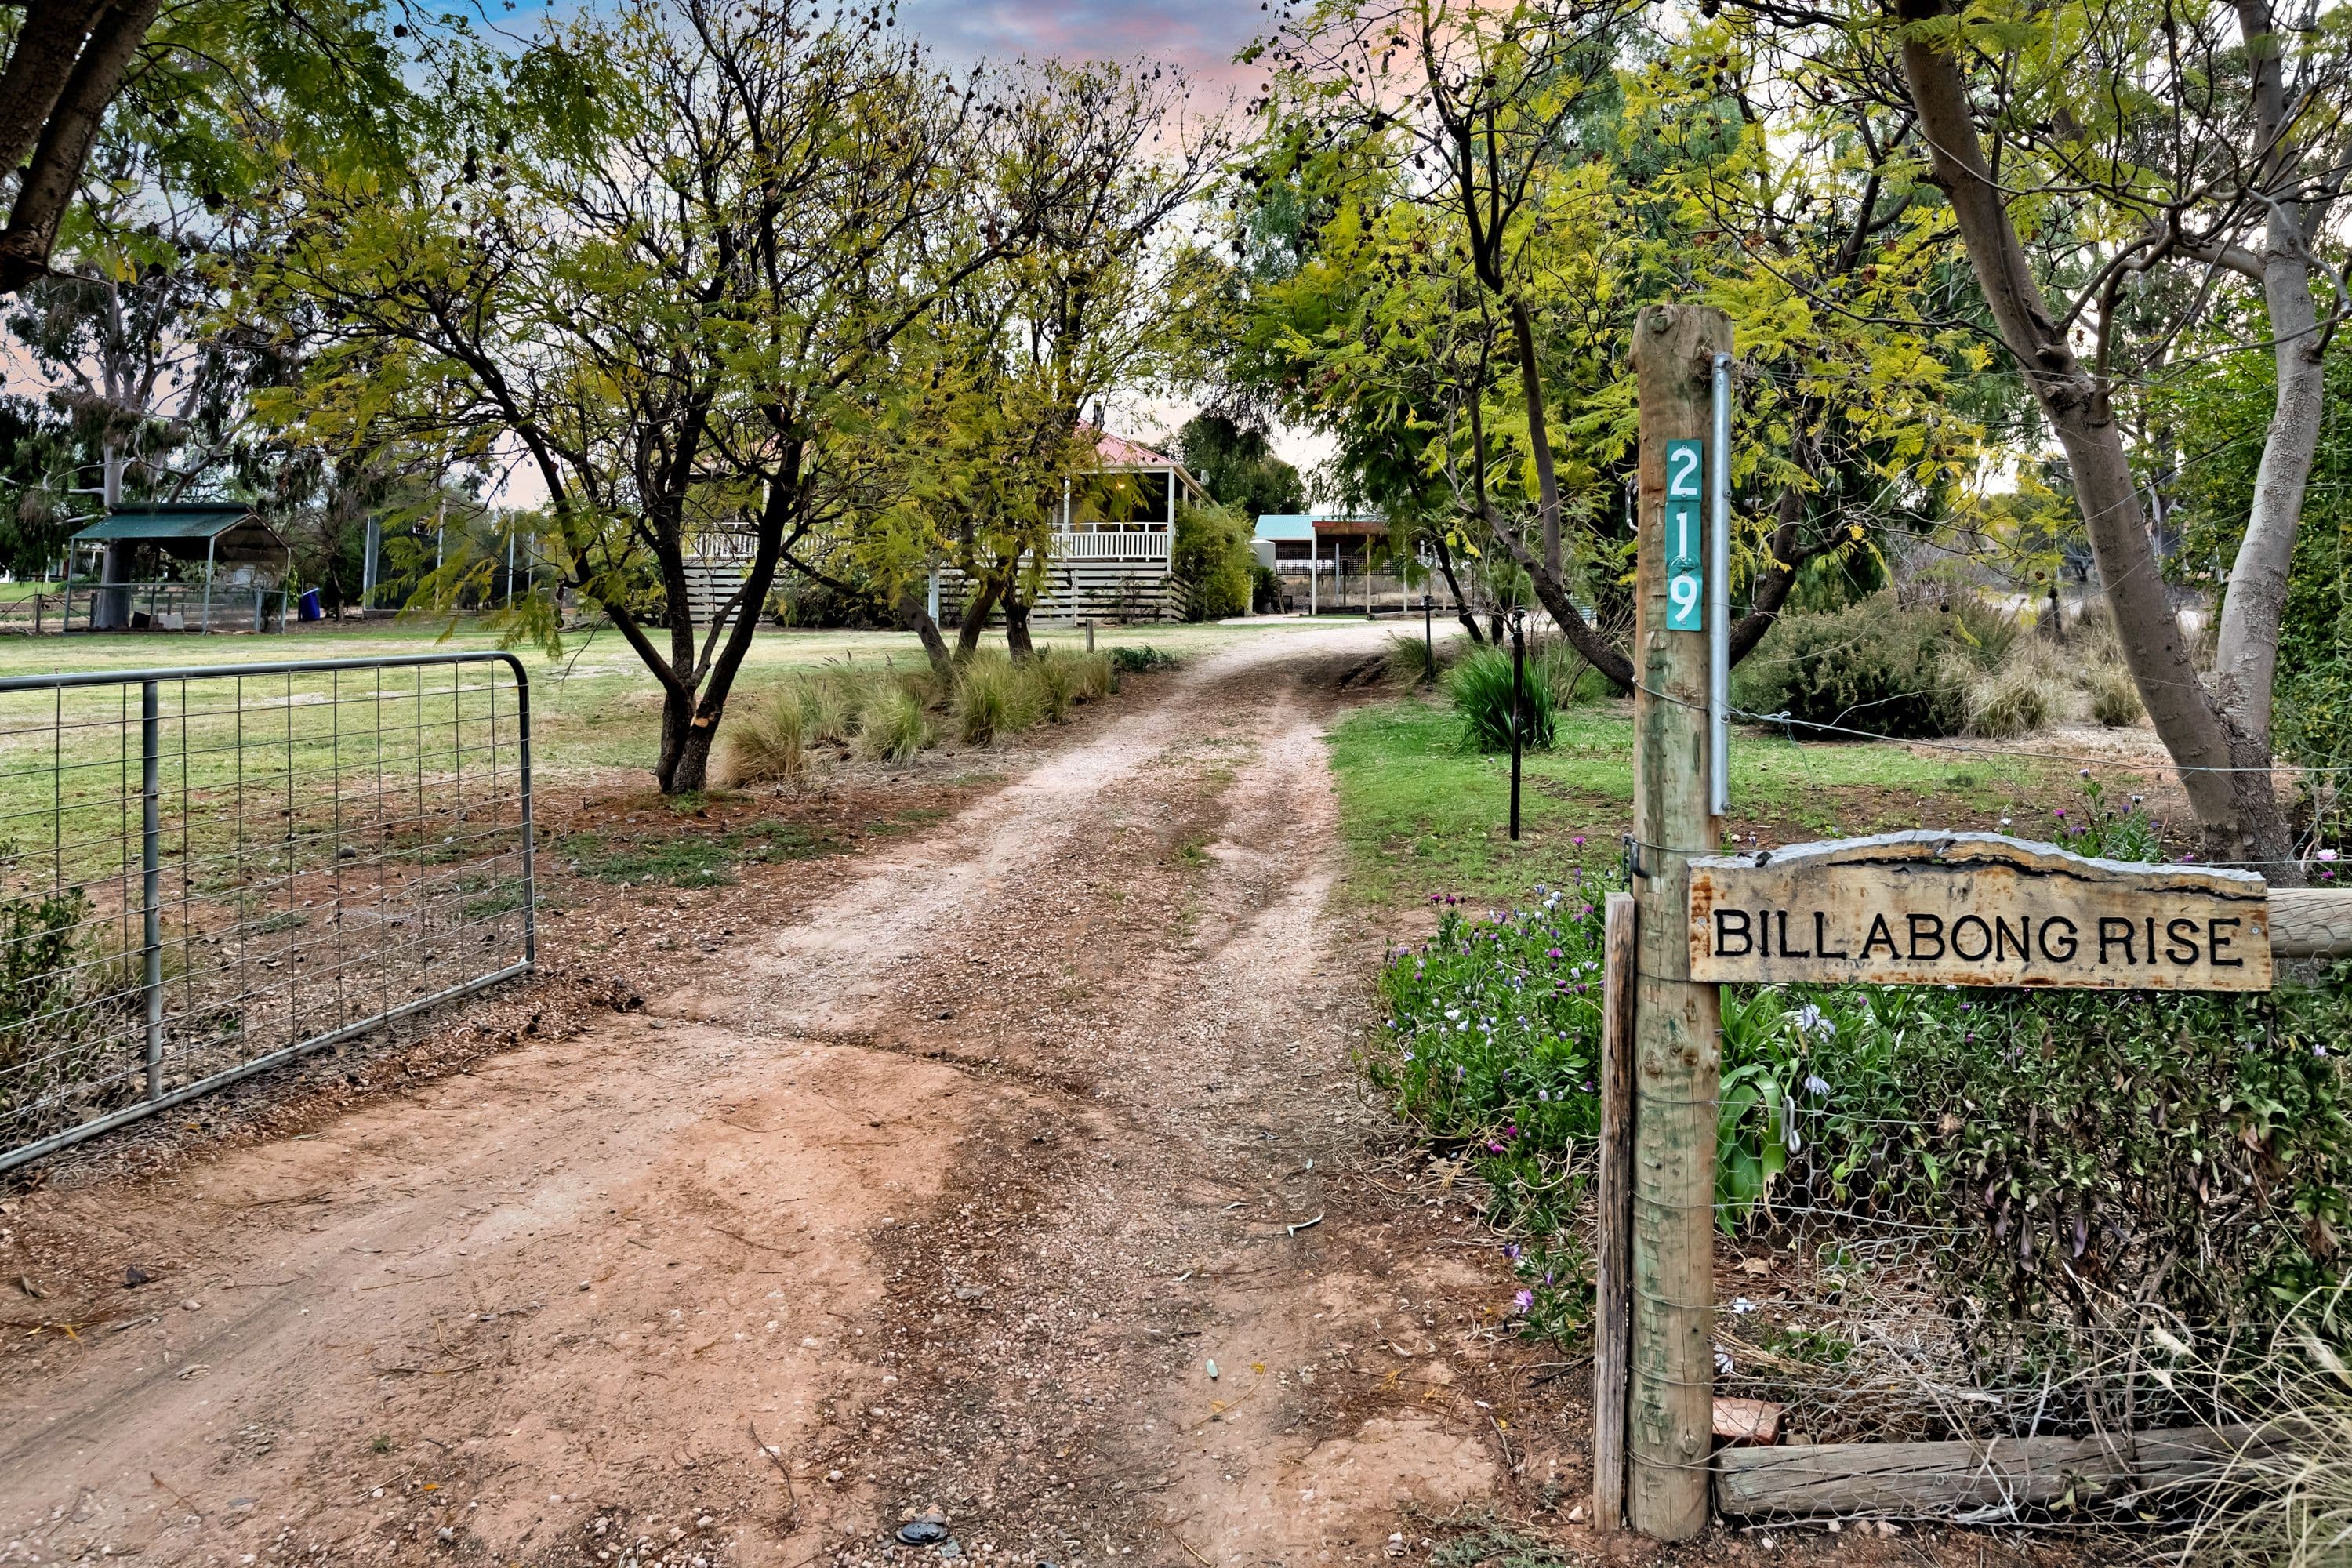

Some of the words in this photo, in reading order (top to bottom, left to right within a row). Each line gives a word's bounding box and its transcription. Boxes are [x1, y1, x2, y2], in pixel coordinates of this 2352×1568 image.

[1669, 448, 1699, 624] 219
[1713, 908, 2078, 964] BILLABONG
[2097, 916, 2245, 967] RISE
